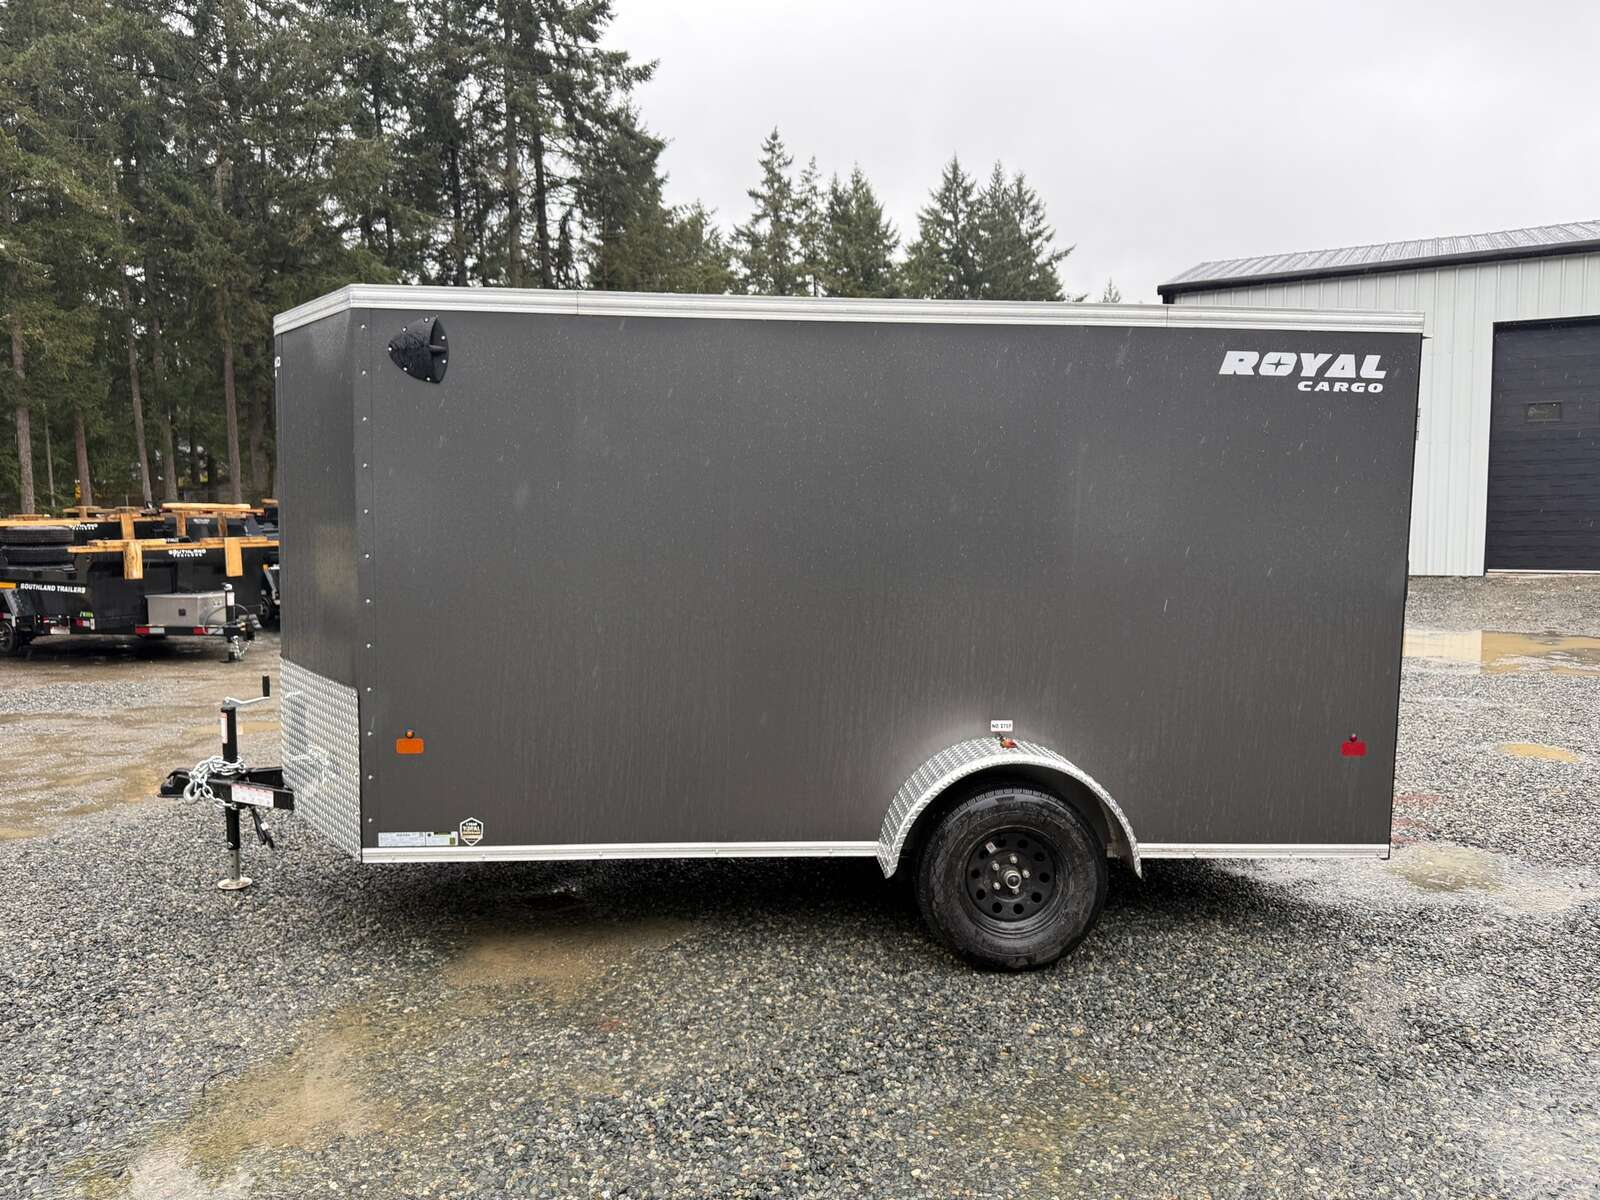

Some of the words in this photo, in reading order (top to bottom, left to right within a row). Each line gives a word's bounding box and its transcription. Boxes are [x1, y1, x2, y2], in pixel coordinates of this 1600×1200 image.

[1218, 350, 1387, 379] ROYAL
[1297, 380, 1384, 393] CARGO
[20, 583, 56, 592] SOUTHLAND
[56, 585, 86, 594] TRAILERS
